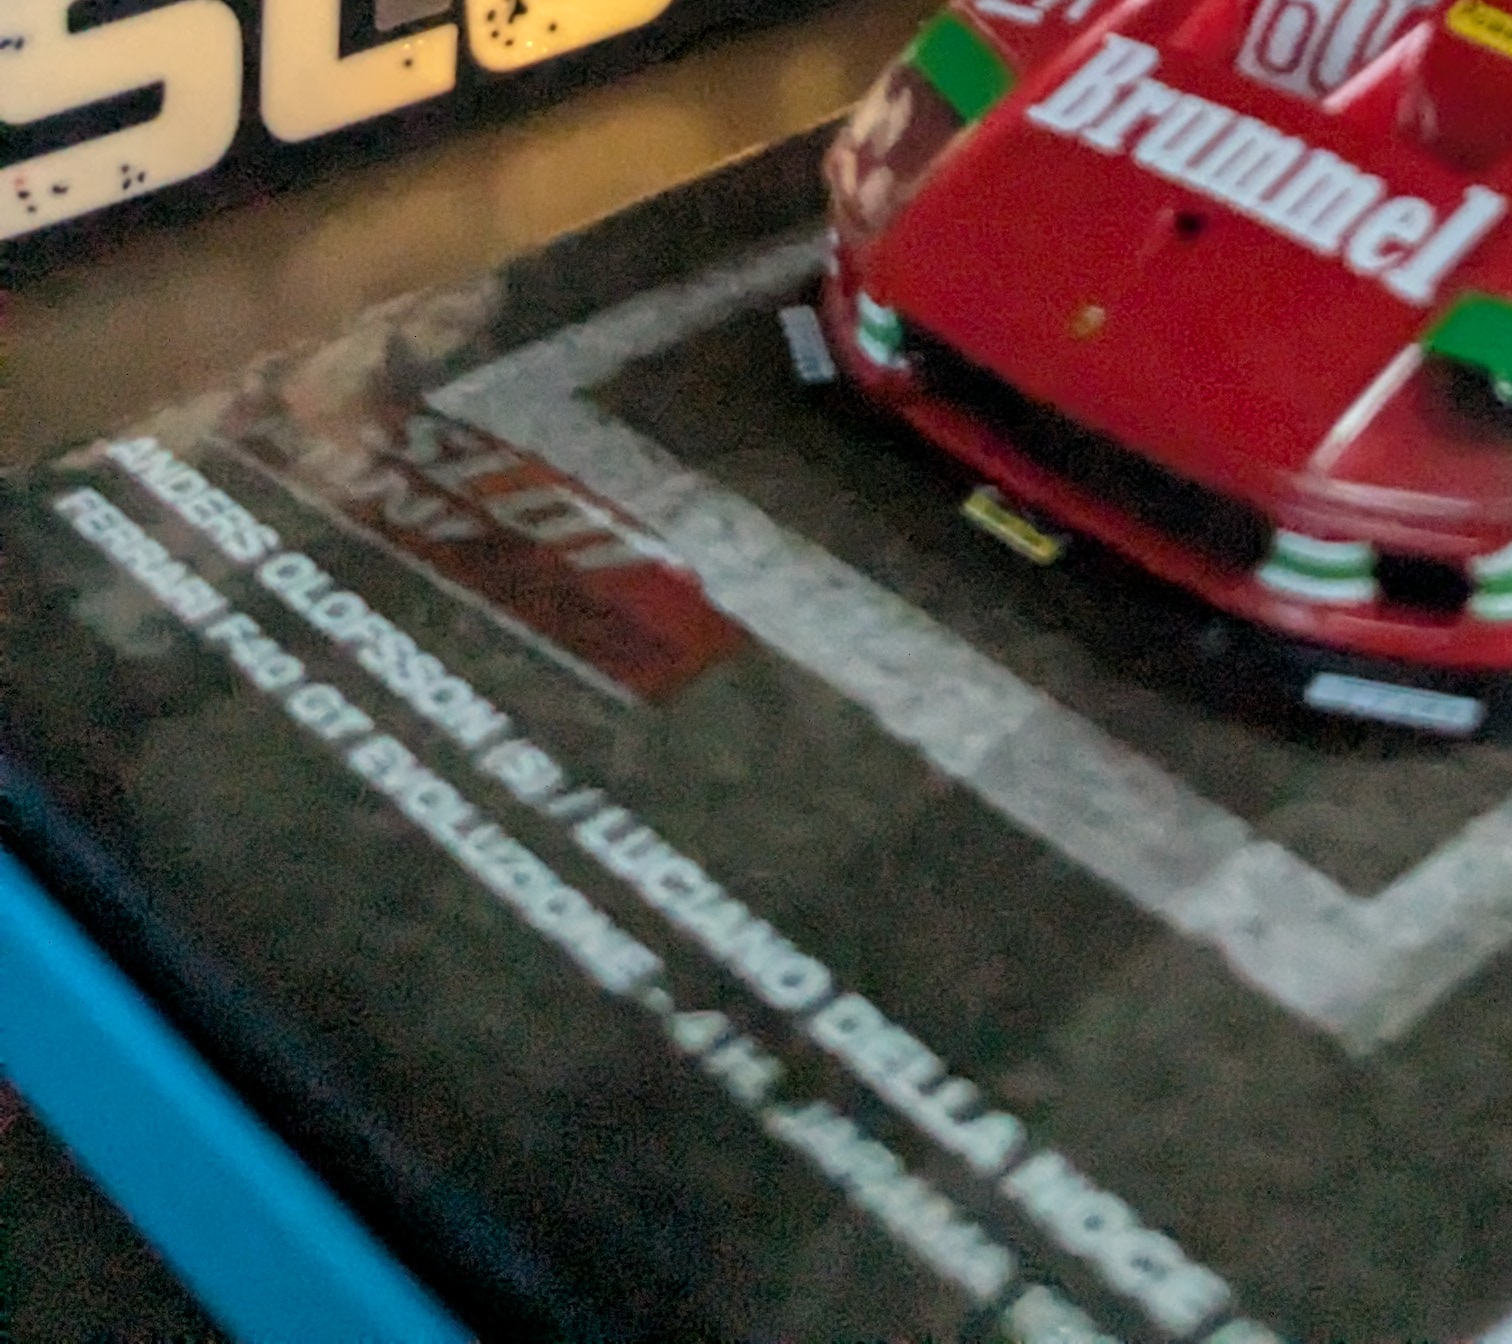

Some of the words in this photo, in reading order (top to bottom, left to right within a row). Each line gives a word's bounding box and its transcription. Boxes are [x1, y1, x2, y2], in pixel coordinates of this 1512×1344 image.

[1026, 32, 1507, 306] Brummel
[54, 485, 228, 624] FERRARI
[205, 611, 306, 693] F40
[106, 435, 281, 566] ANDERS
[257, 550, 508, 750] OLOFSSON
[573, 807, 833, 1011] LUCIANO
[808, 991, 1027, 1177] DELLA
